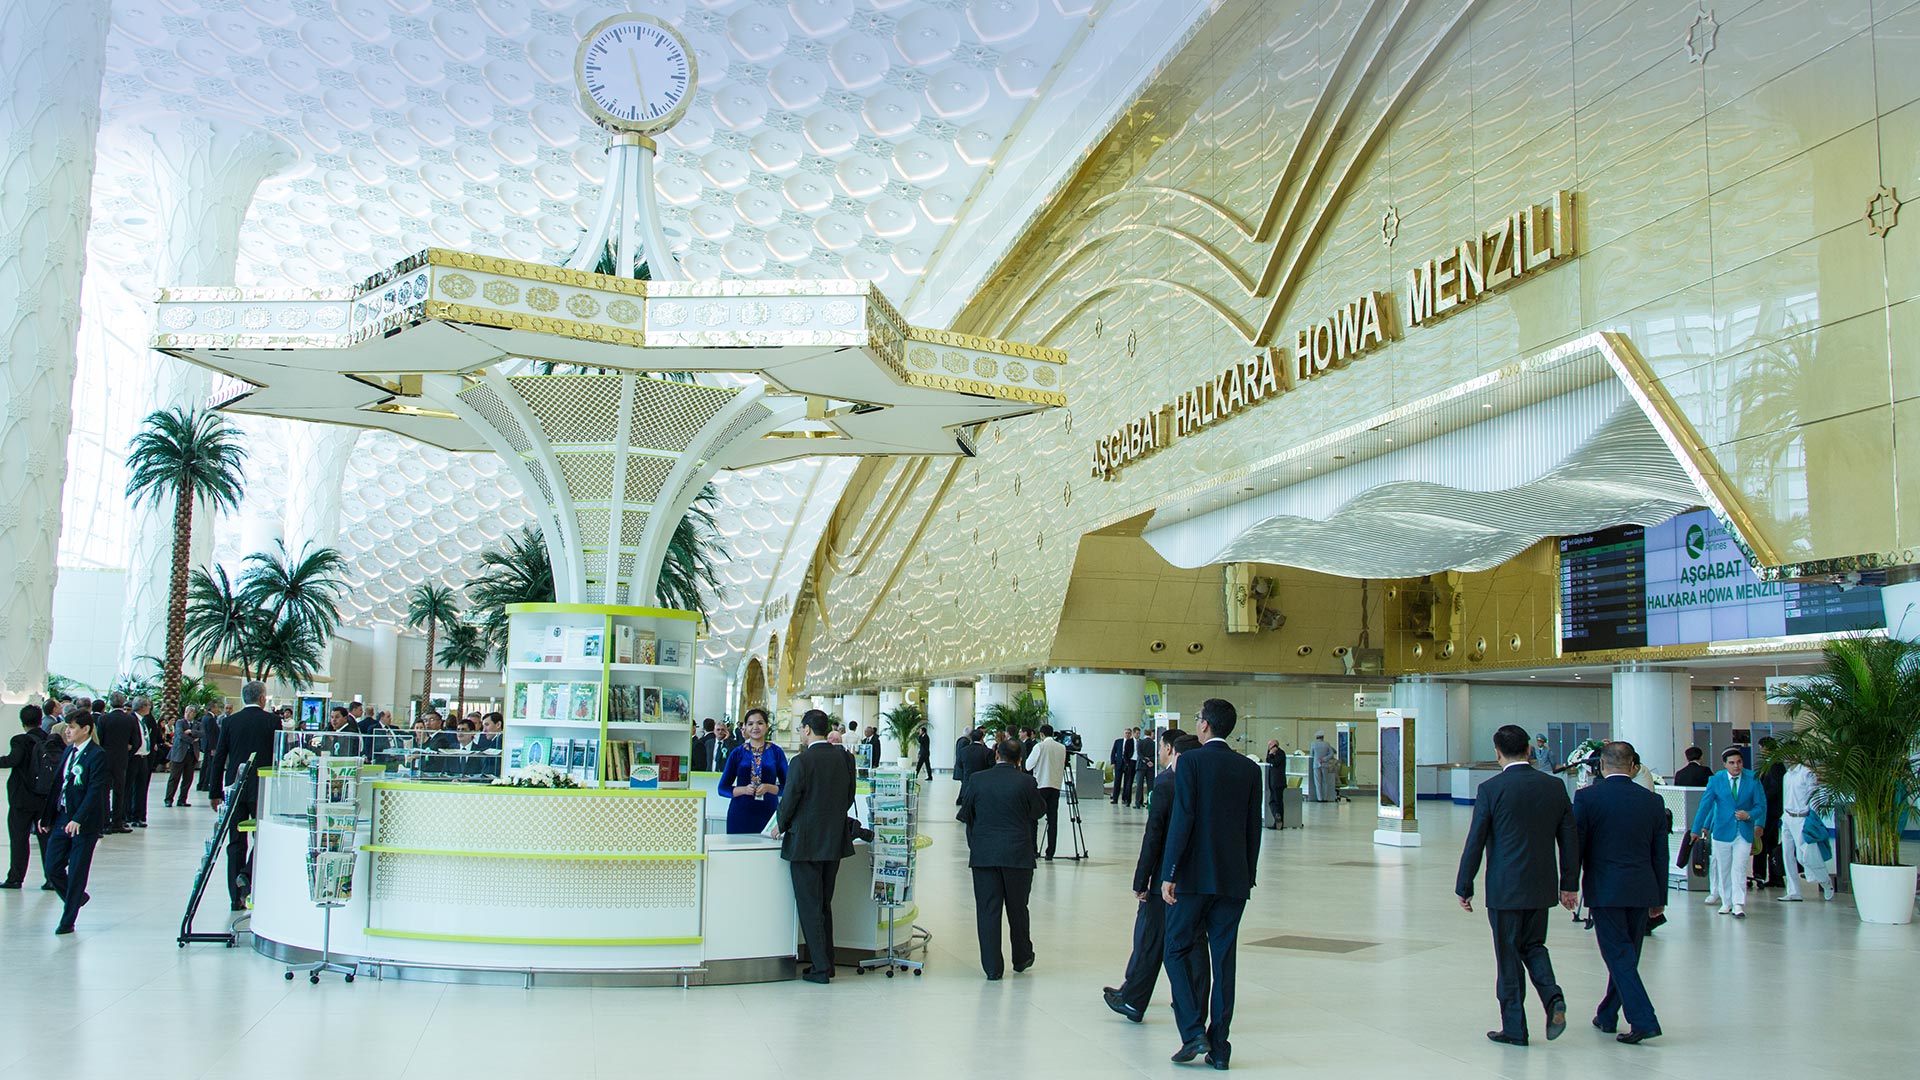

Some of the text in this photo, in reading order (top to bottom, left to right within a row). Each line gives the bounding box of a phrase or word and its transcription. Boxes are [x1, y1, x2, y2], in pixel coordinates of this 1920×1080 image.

[1091, 190, 1570, 482] AŞGABAT HALKARA HOWA MENZILI
[1680, 559, 1742, 587] AŞGABAT
[1647, 590, 1698, 610] HALKARA
[1699, 586, 1734, 605] HOWA
[1736, 581, 1783, 602] MENZILI
[904, 688, 916, 706] C
